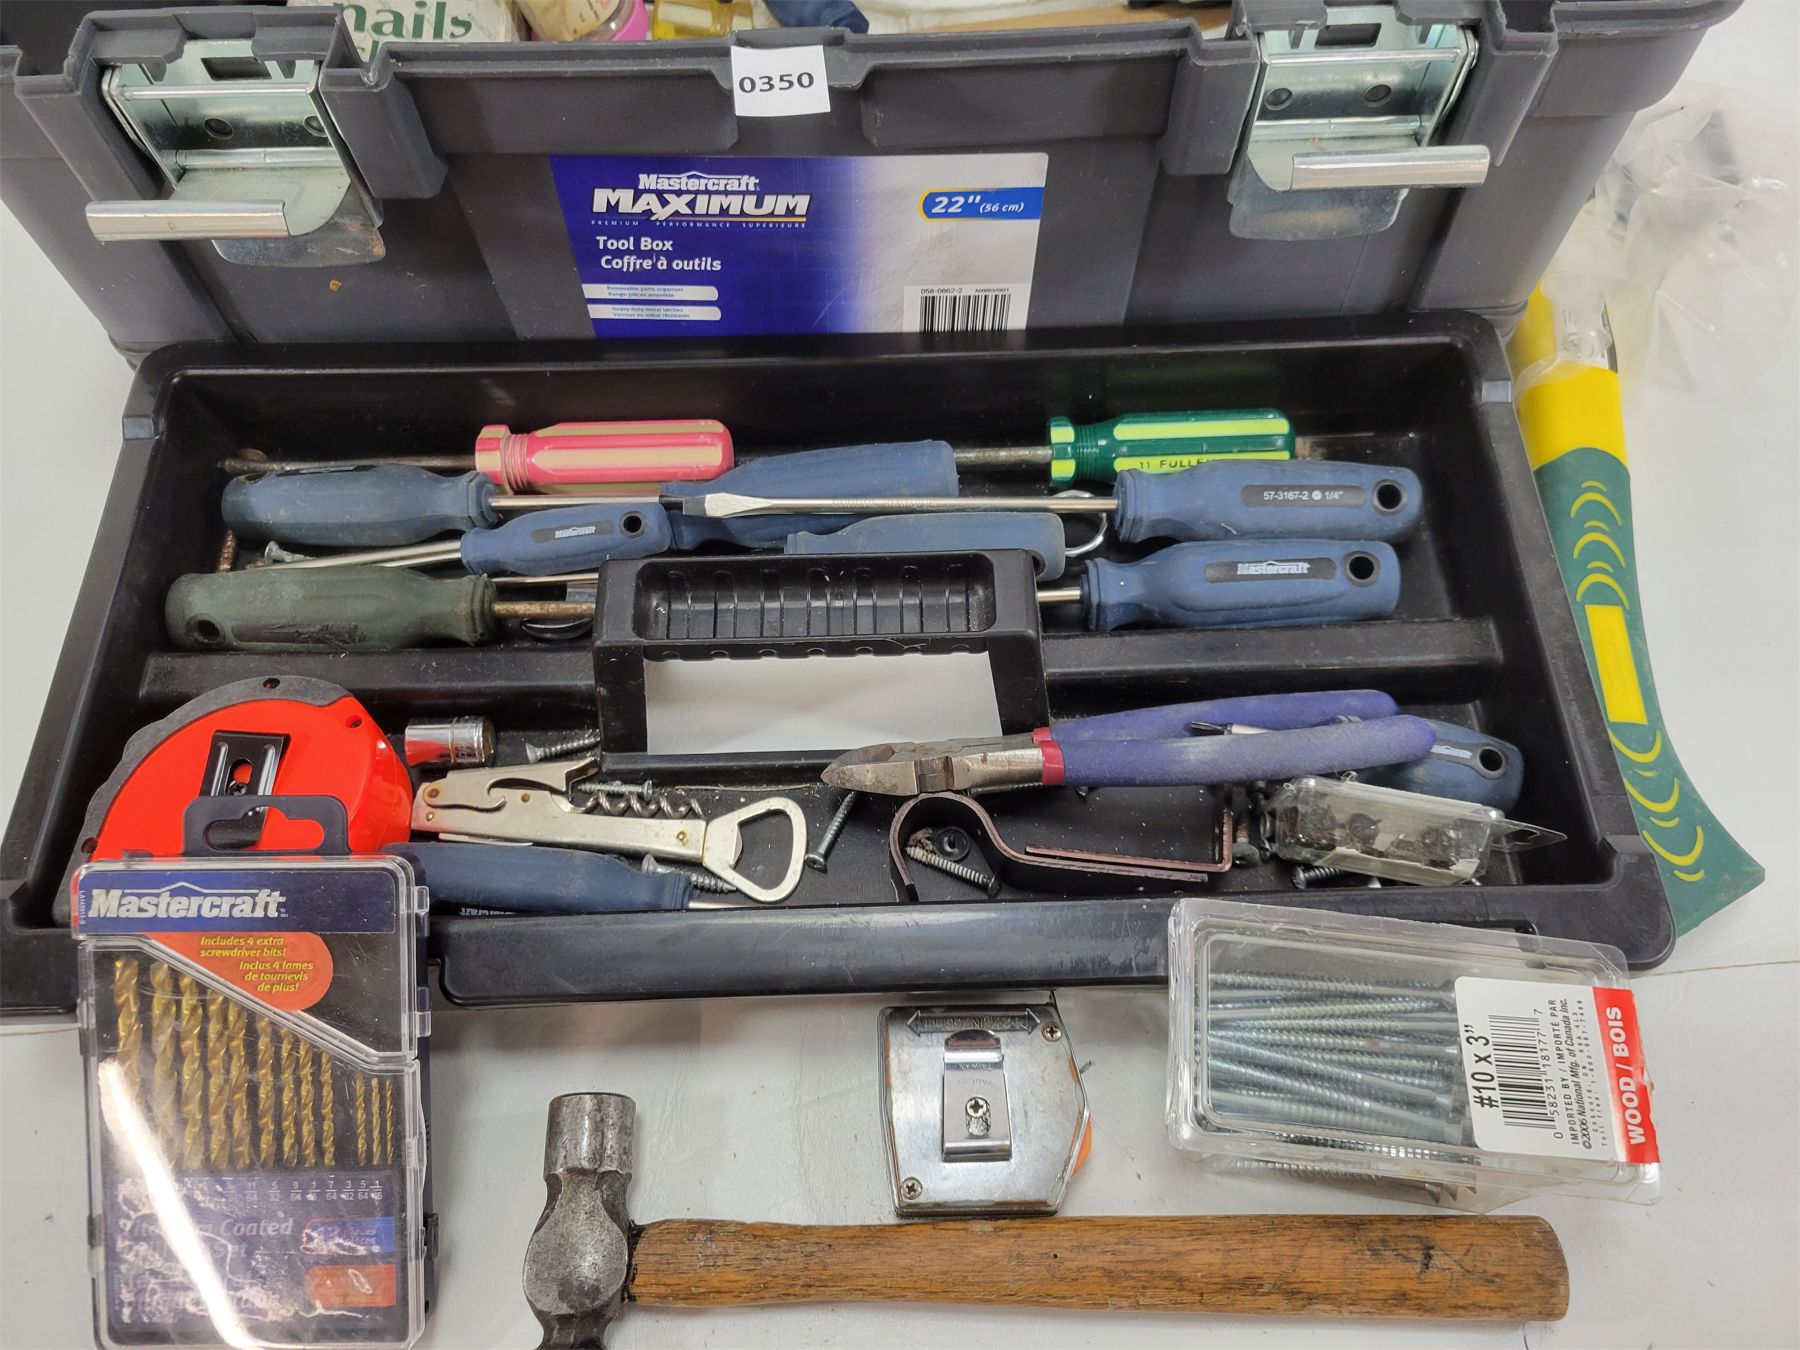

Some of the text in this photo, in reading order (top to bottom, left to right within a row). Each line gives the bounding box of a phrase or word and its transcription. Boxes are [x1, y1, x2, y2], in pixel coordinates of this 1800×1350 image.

[335, 0, 473, 40] nails
[737, 71, 815, 95] 0350
[638, 171, 759, 192] Mastercraft
[592, 188, 811, 220] MAXIMUM
[931, 194, 1025, 214] 22" (56 cm)
[596, 236, 674, 251] Tool Box
[600, 255, 722, 272] Coffre à outils
[1263, 490, 1310, 501] 57-3167-2
[88, 884, 286, 919] Mastercraft
[200, 936, 283, 946] Includes 4 extra
[199, 947, 287, 958] screwdriver bits!
[239, 960, 314, 971] Inclus 4 lames
[244, 971, 309, 982] de tournevis
[257, 982, 299, 994] de plus!
[1548, 999, 1558, 1018] PAR
[1561, 998, 1570, 1013] Inc.
[1564, 1013, 1577, 1047] Canada
[1536, 1031, 1551, 1070] 18177
[1552, 1021, 1565, 1064] IMPORTÉ
[1567, 1046, 1576, 1059] of
[1474, 1053, 1493, 1066] x
[1569, 1059, 1582, 1082] Mfg.
[1605, 1005, 1647, 1146] WOOD / BOIS
[1471, 1071, 1500, 1109] #10
[1561, 1076, 1571, 1090] BY
[1545, 1077, 1560, 1116] 58231
[1573, 1081, 1587, 1118] National
[1565, 1092, 1579, 1145] IMPORTED
[221, 1218, 294, 1238] Coated
